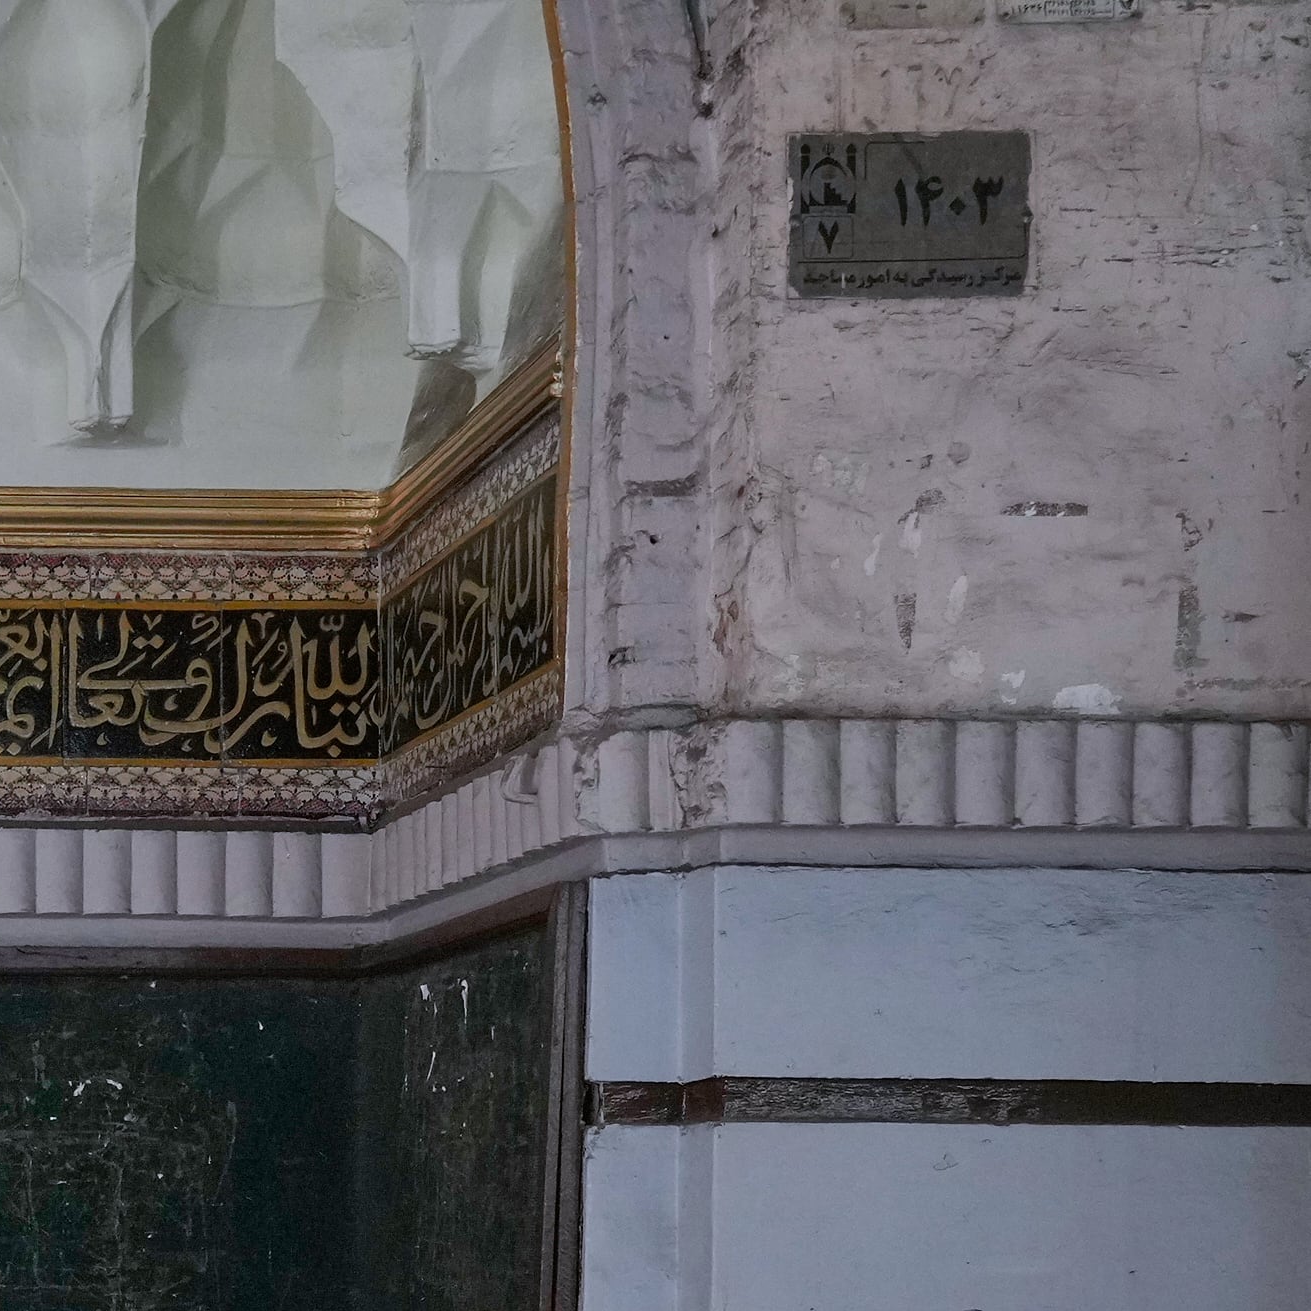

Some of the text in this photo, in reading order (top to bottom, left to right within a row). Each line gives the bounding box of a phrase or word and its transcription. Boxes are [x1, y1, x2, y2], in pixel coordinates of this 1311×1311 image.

[894, 174, 1005, 229] ۱۴۰۳
[817, 220, 839, 255] ۷
[856, 268, 890, 290] امور
[892, 270, 910, 287] به
[911, 268, 974, 289] رسیدگی
[975, 265, 1023, 288] مرکز
